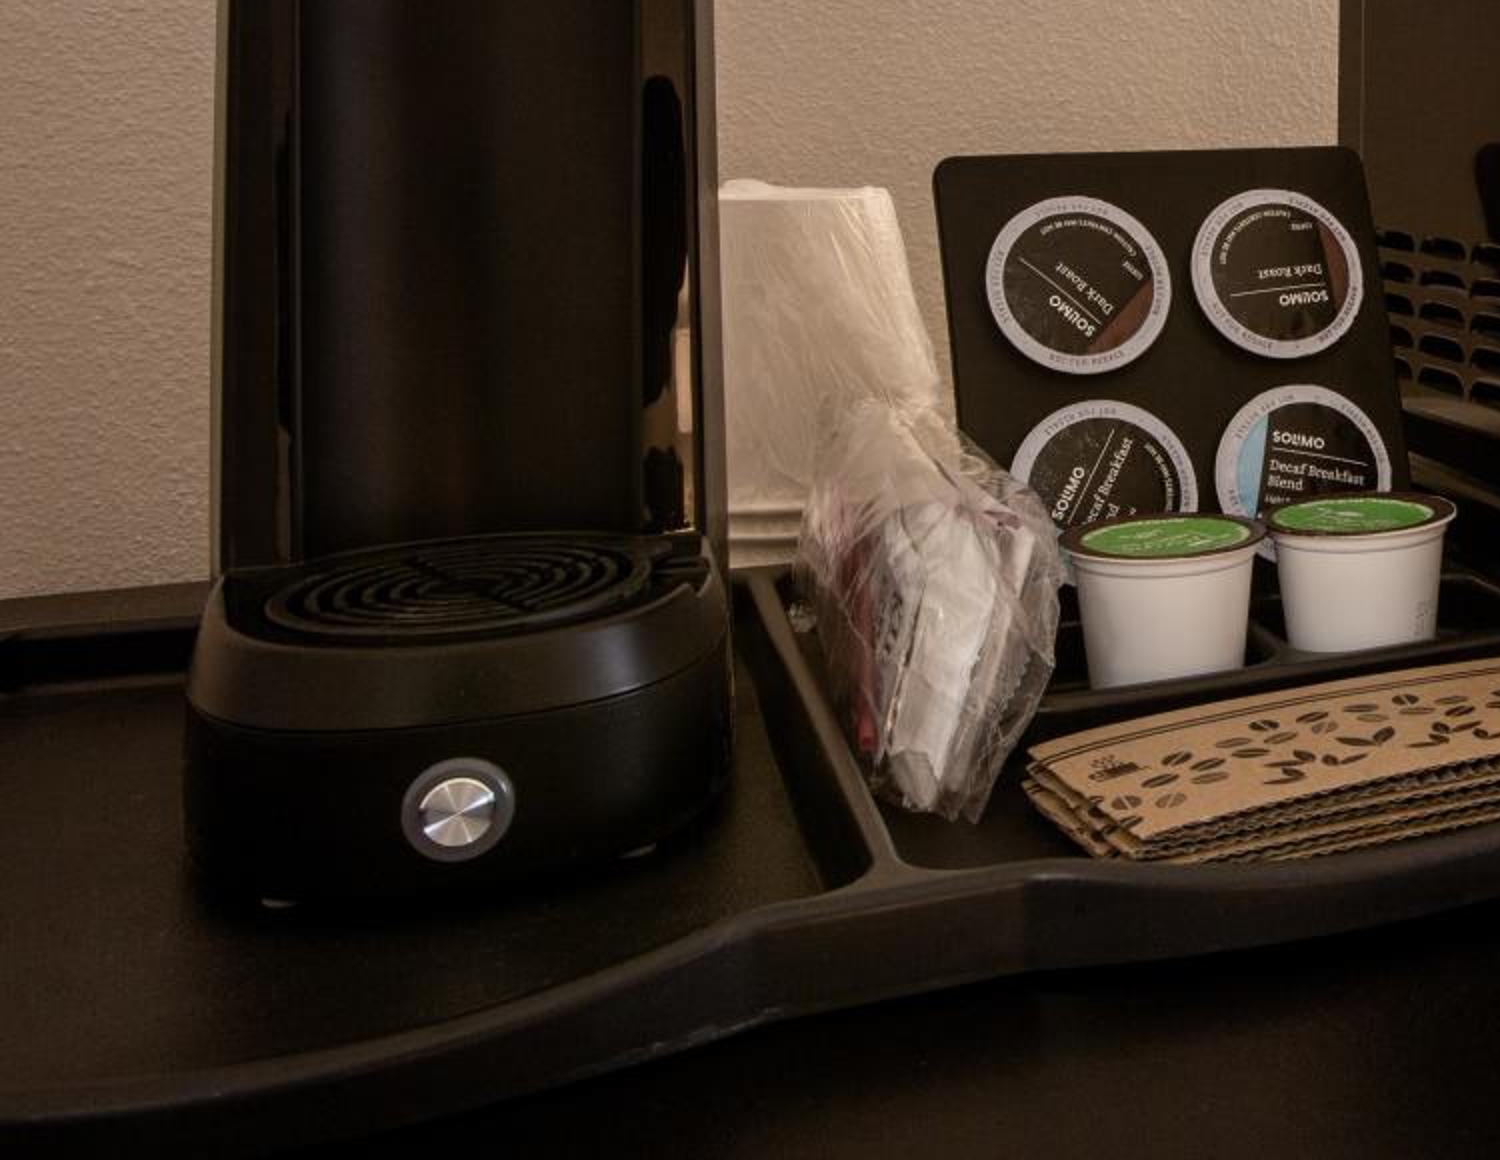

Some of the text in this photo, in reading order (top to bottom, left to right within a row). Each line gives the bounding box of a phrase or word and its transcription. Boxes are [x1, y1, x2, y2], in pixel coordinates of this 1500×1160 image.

[1054, 260, 1090, 293] Roast
[1257, 263, 1323, 280] Dark Roast
[1048, 294, 1098, 337] SOLIMO
[1085, 287, 1114, 317] Dark
[1271, 430, 1326, 450] SOLIMO
[1266, 474, 1304, 492] Blend
[1268, 458, 1366, 487] Decaf Breakfast
[1050, 465, 1086, 521] SOLIMO
[1083, 493, 1104, 525] ecaf
